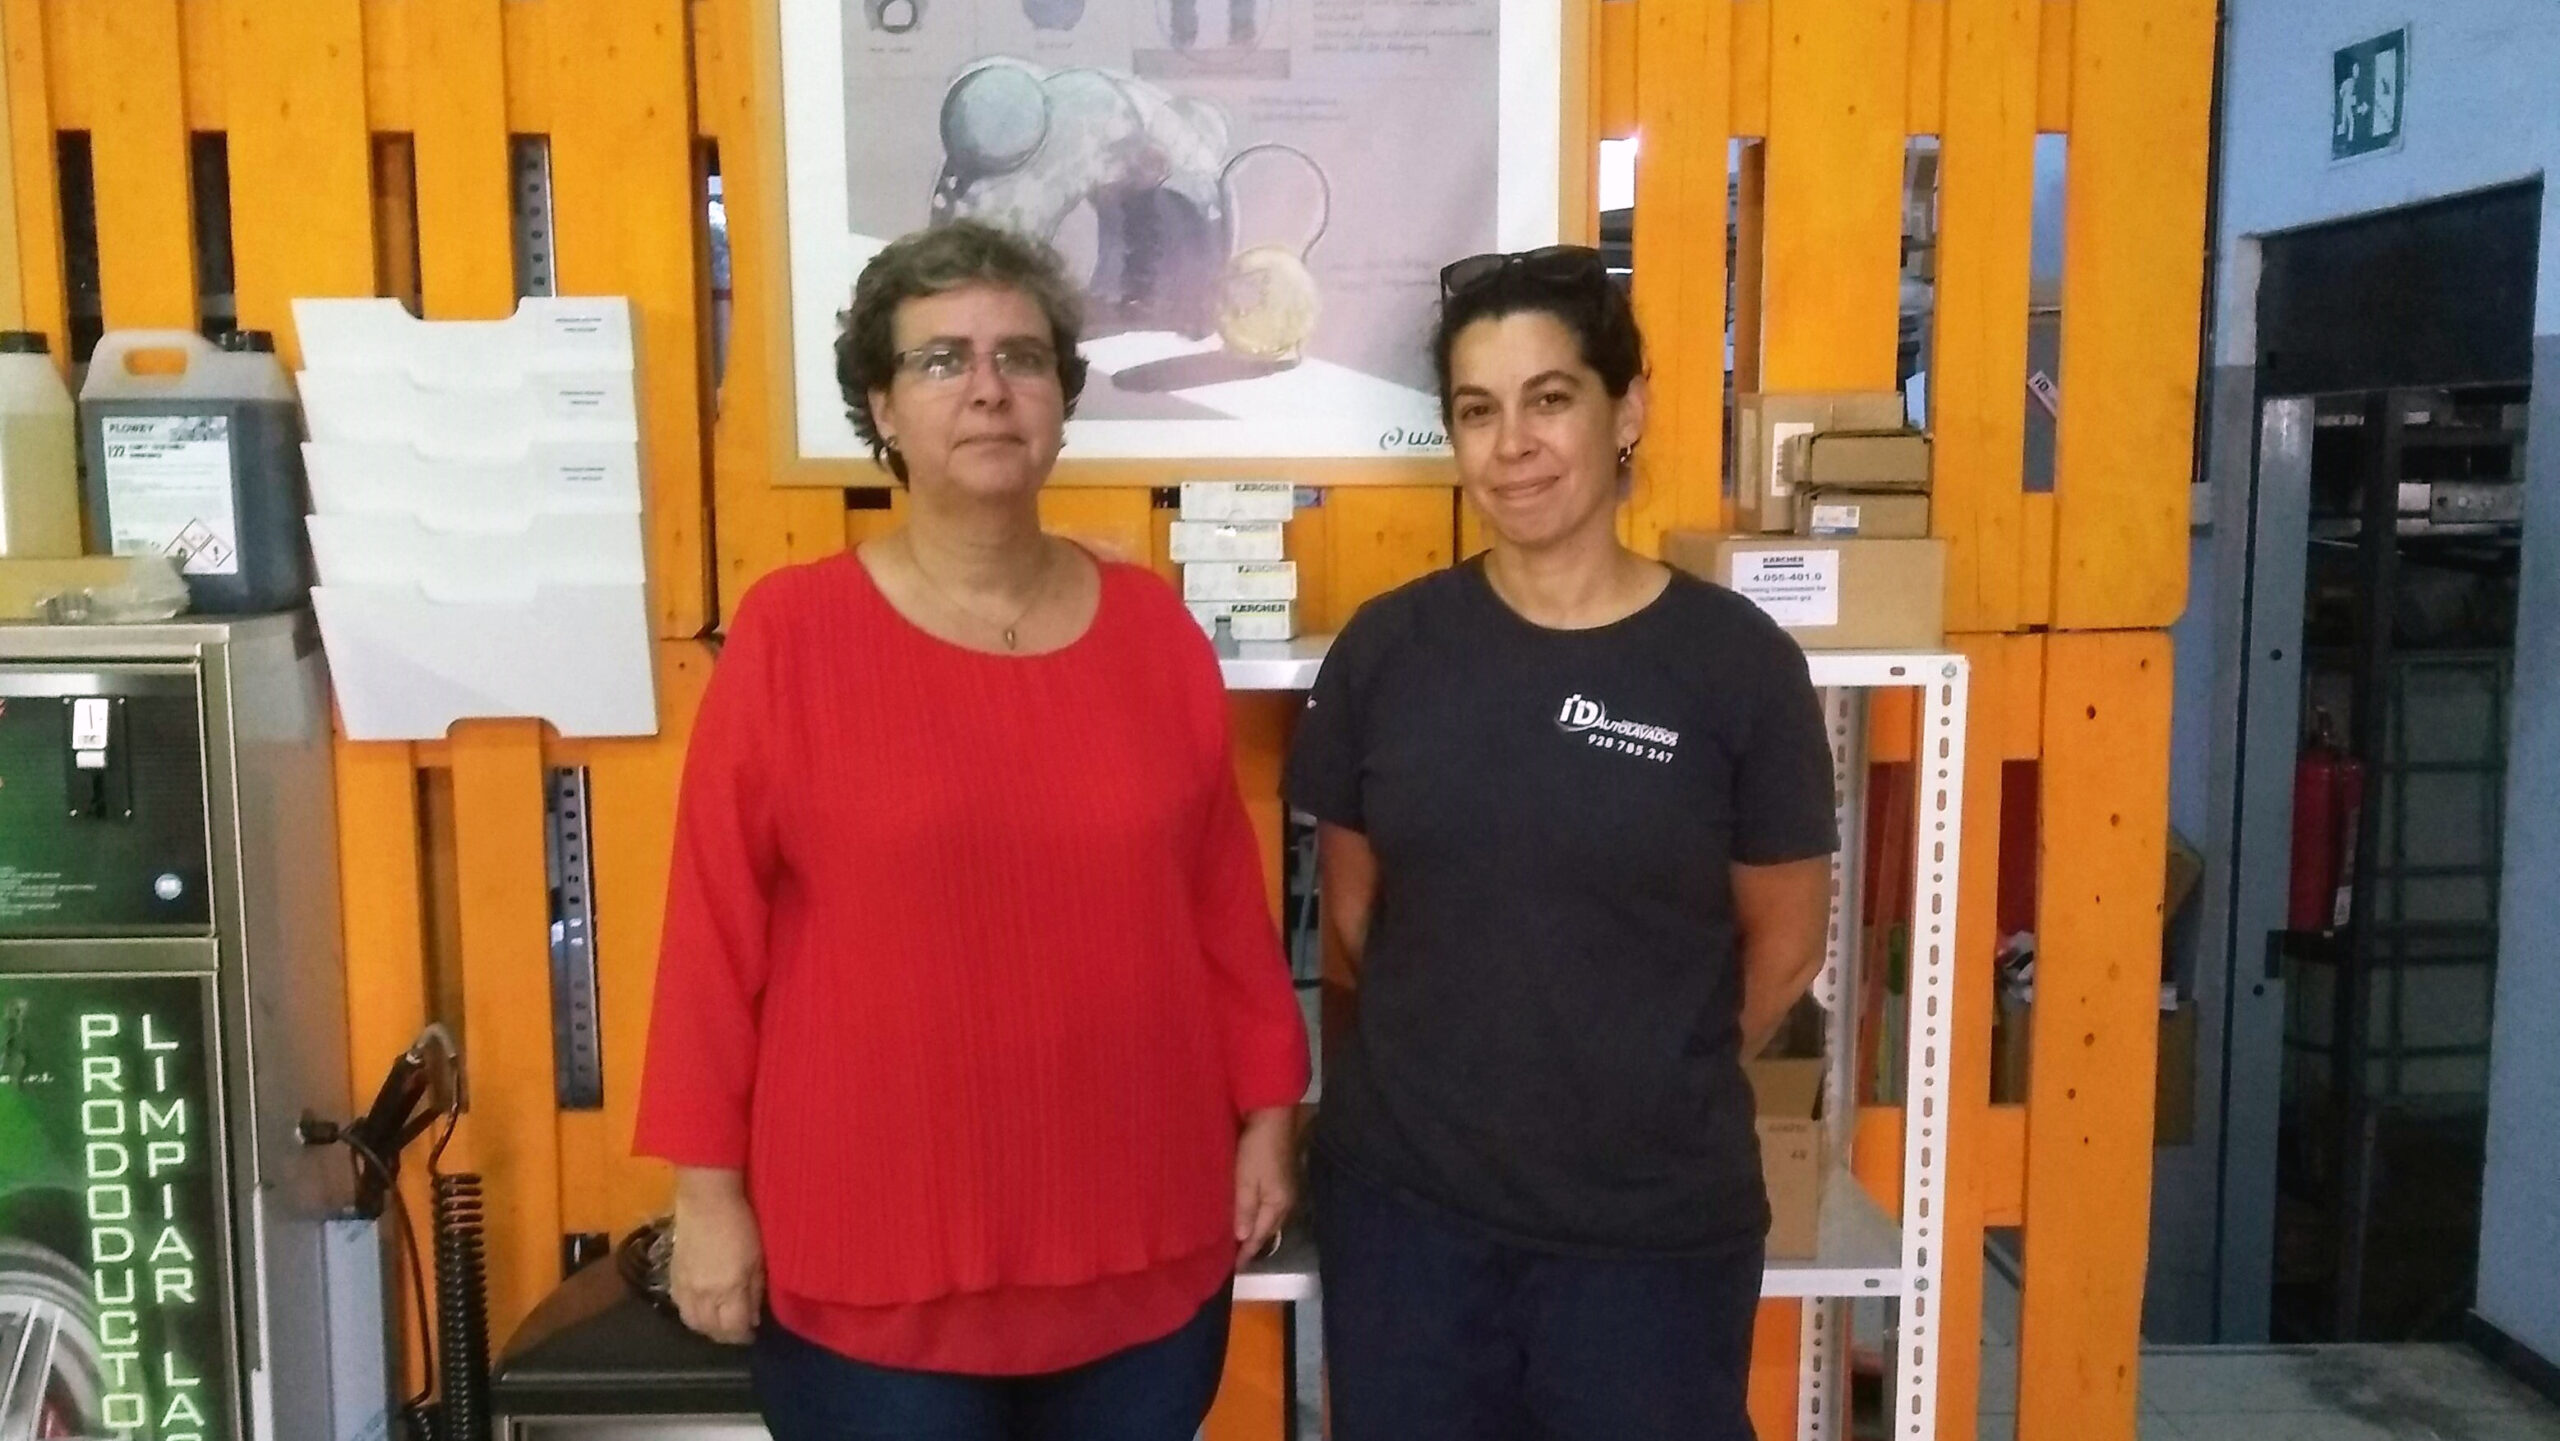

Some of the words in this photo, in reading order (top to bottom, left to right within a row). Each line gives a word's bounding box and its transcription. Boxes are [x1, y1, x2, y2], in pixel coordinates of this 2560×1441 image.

[1588, 733, 1615, 749] 928
[1647, 747, 1674, 764] 247
[139, 1013, 196, 1304] LIMPIAR
[160, 1351, 205, 1441] LA
